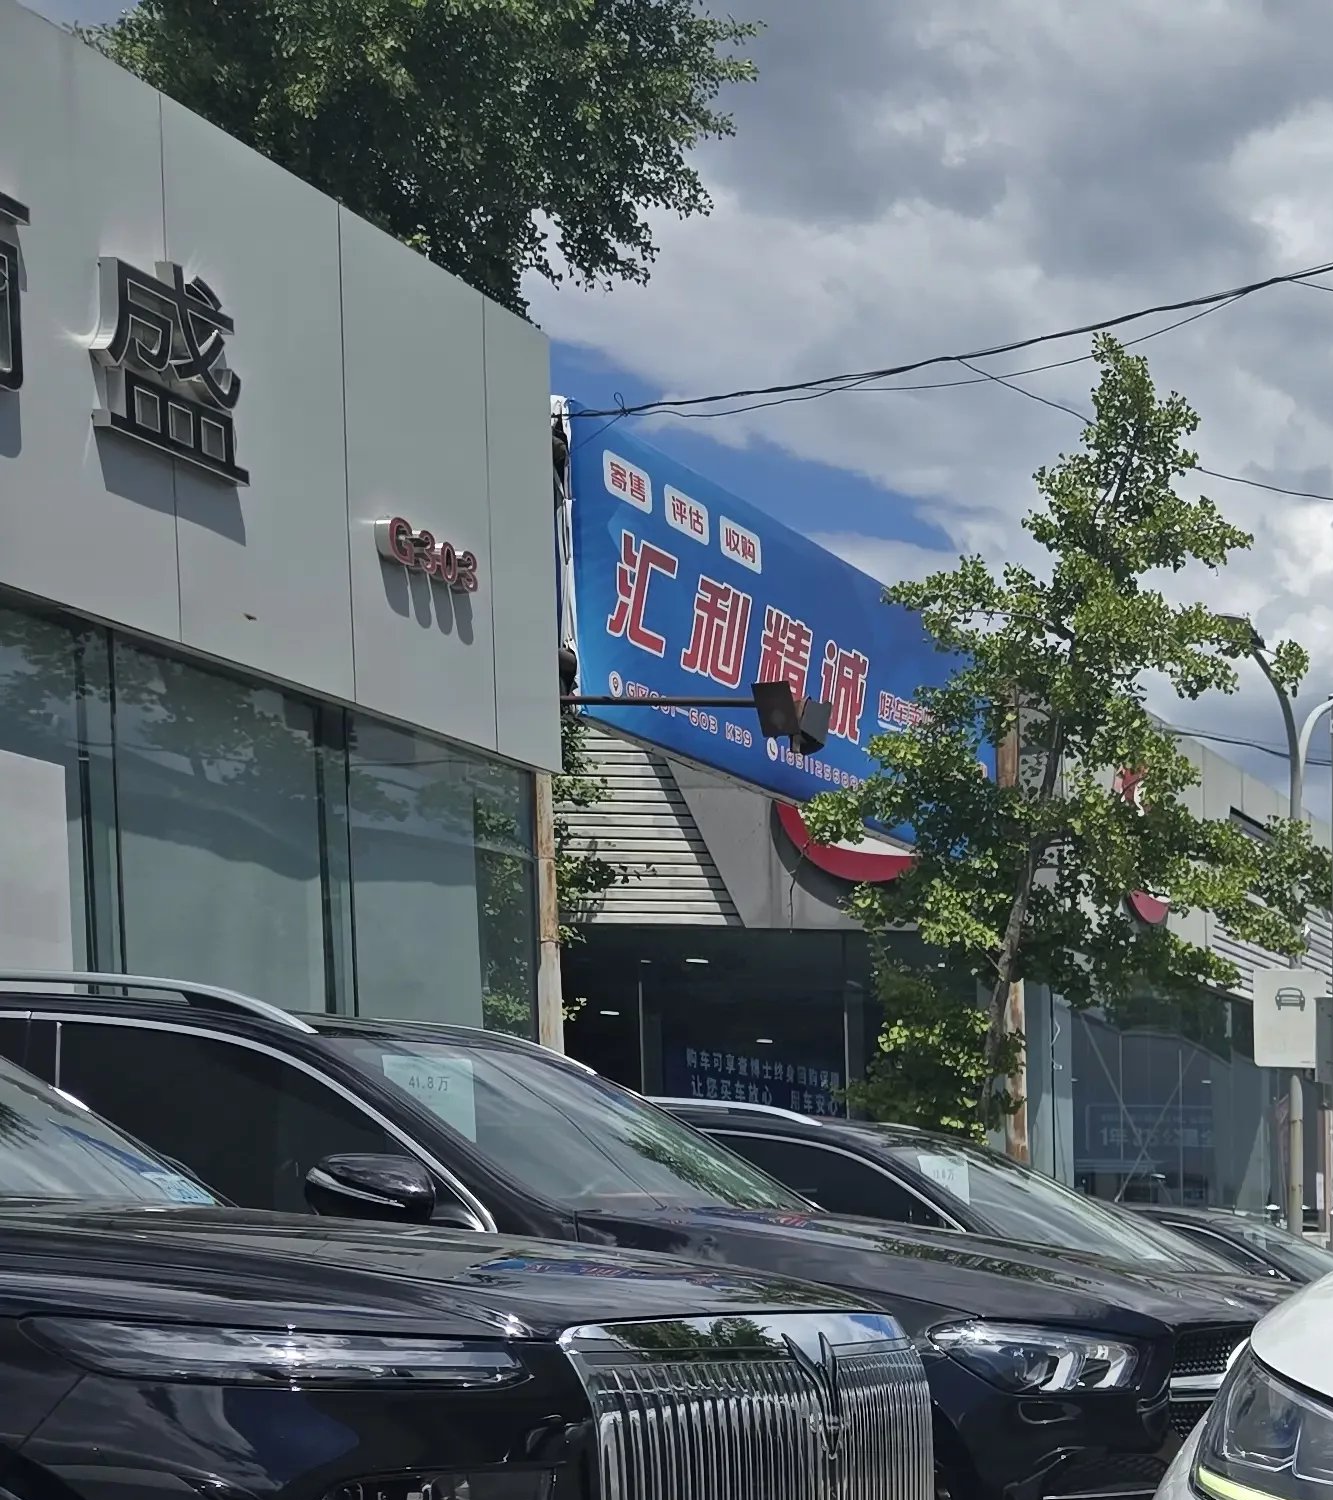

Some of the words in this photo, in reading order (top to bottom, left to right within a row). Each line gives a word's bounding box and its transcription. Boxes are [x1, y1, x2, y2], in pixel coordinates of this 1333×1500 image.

[374, 516, 478, 593] G303
[610, 461, 646, 502] 寄售
[671, 495, 704, 535] 评估
[725, 527, 756, 563] 收购
[606, 529, 870, 745] 汇利精诚
[408, 1075, 450, 1092] 41.8万
